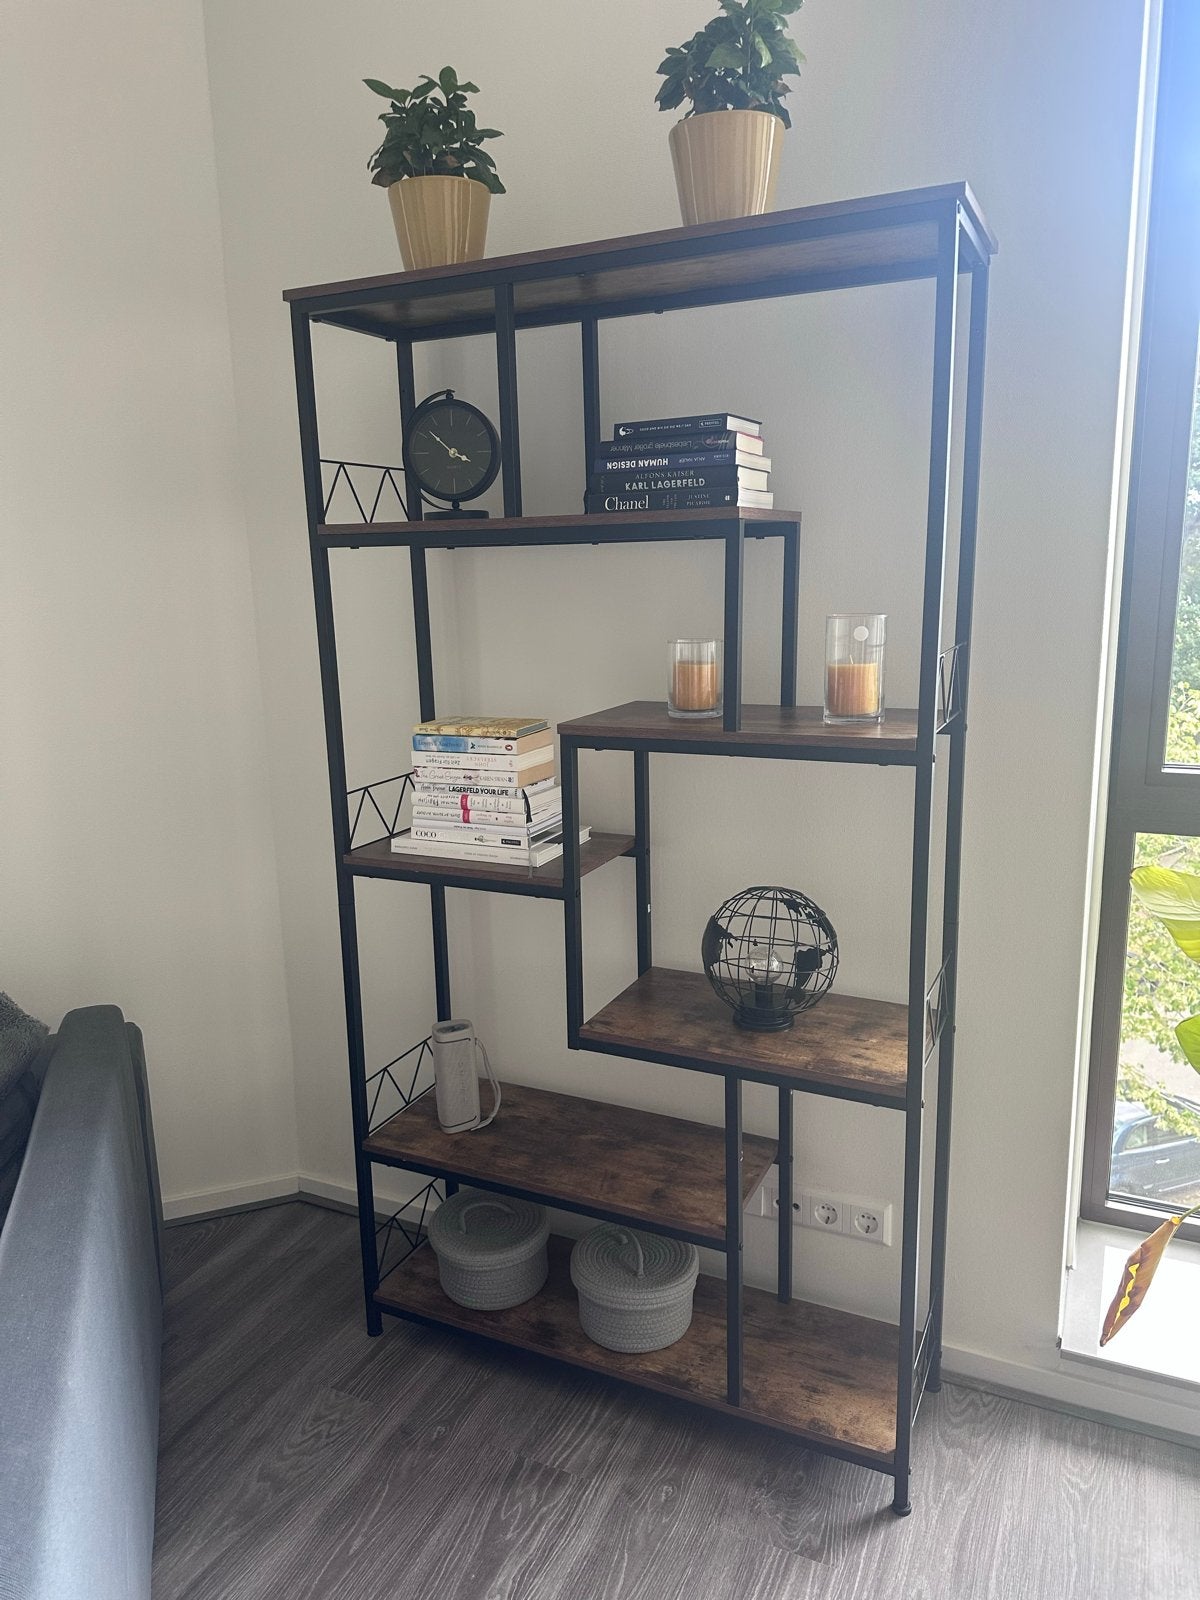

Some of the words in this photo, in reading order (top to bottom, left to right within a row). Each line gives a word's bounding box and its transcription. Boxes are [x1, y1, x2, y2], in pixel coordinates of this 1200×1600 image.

[606, 460, 638, 470] DESIGN
[638, 457, 669, 467] HUMAN
[635, 472, 665, 480] ALFONS
[666, 470, 695, 478] KAISER
[625, 480, 649, 491] KARL
[651, 478, 706, 490] LAGERFELD
[604, 494, 649, 511] Chanel
[448, 785, 479, 794] LAGERFELD
[480, 787, 497, 795] YOUR
[497, 788, 509, 796] LIFE
[415, 830, 437, 839] COCO
